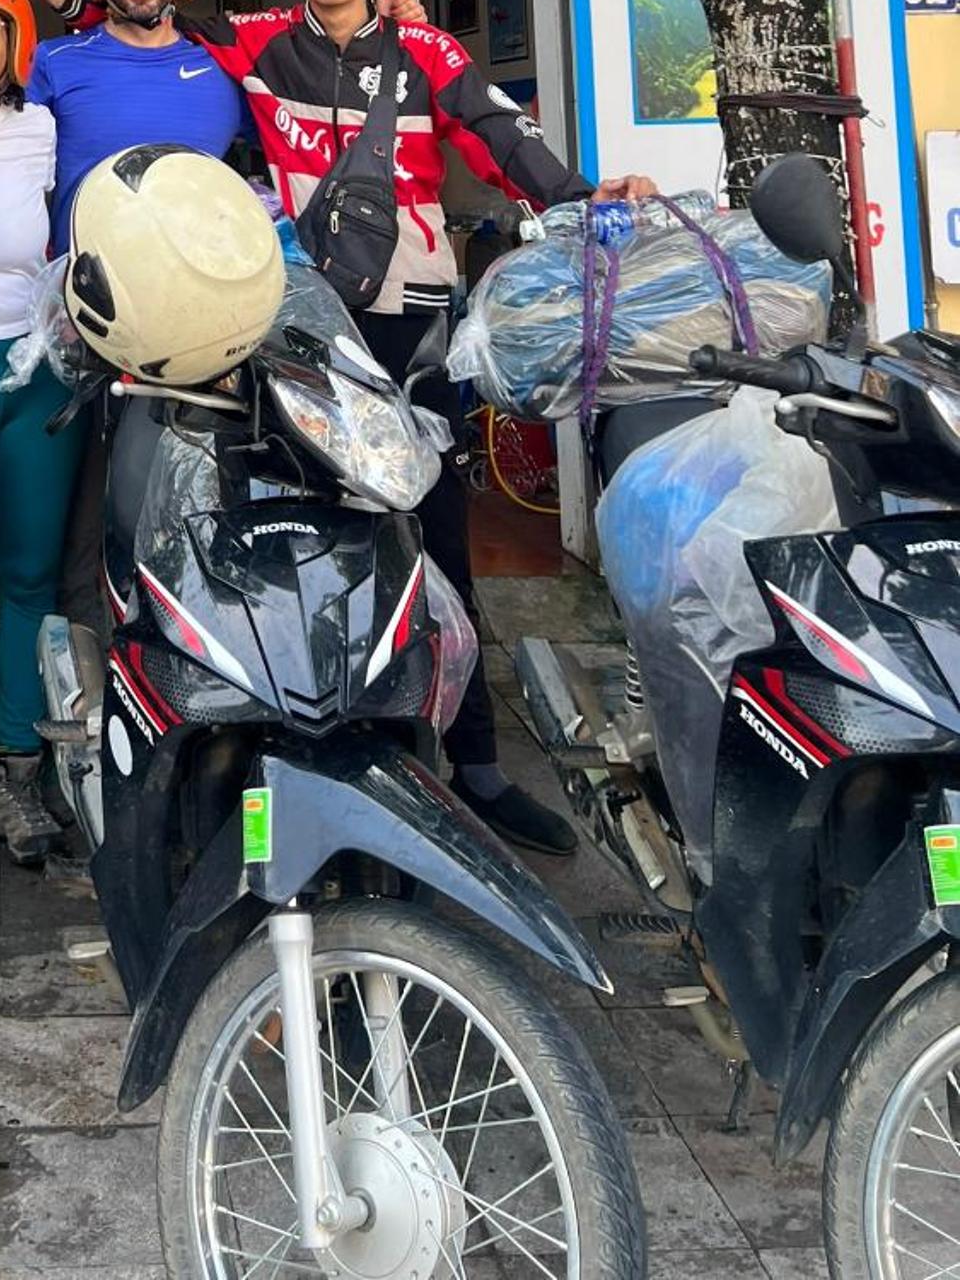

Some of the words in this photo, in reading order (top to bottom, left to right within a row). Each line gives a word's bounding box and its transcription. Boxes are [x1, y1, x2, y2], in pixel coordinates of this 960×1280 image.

[253, 522, 320, 535] HONDA
[113, 674, 154, 747] HONDA
[739, 703, 809, 780] HONDA
